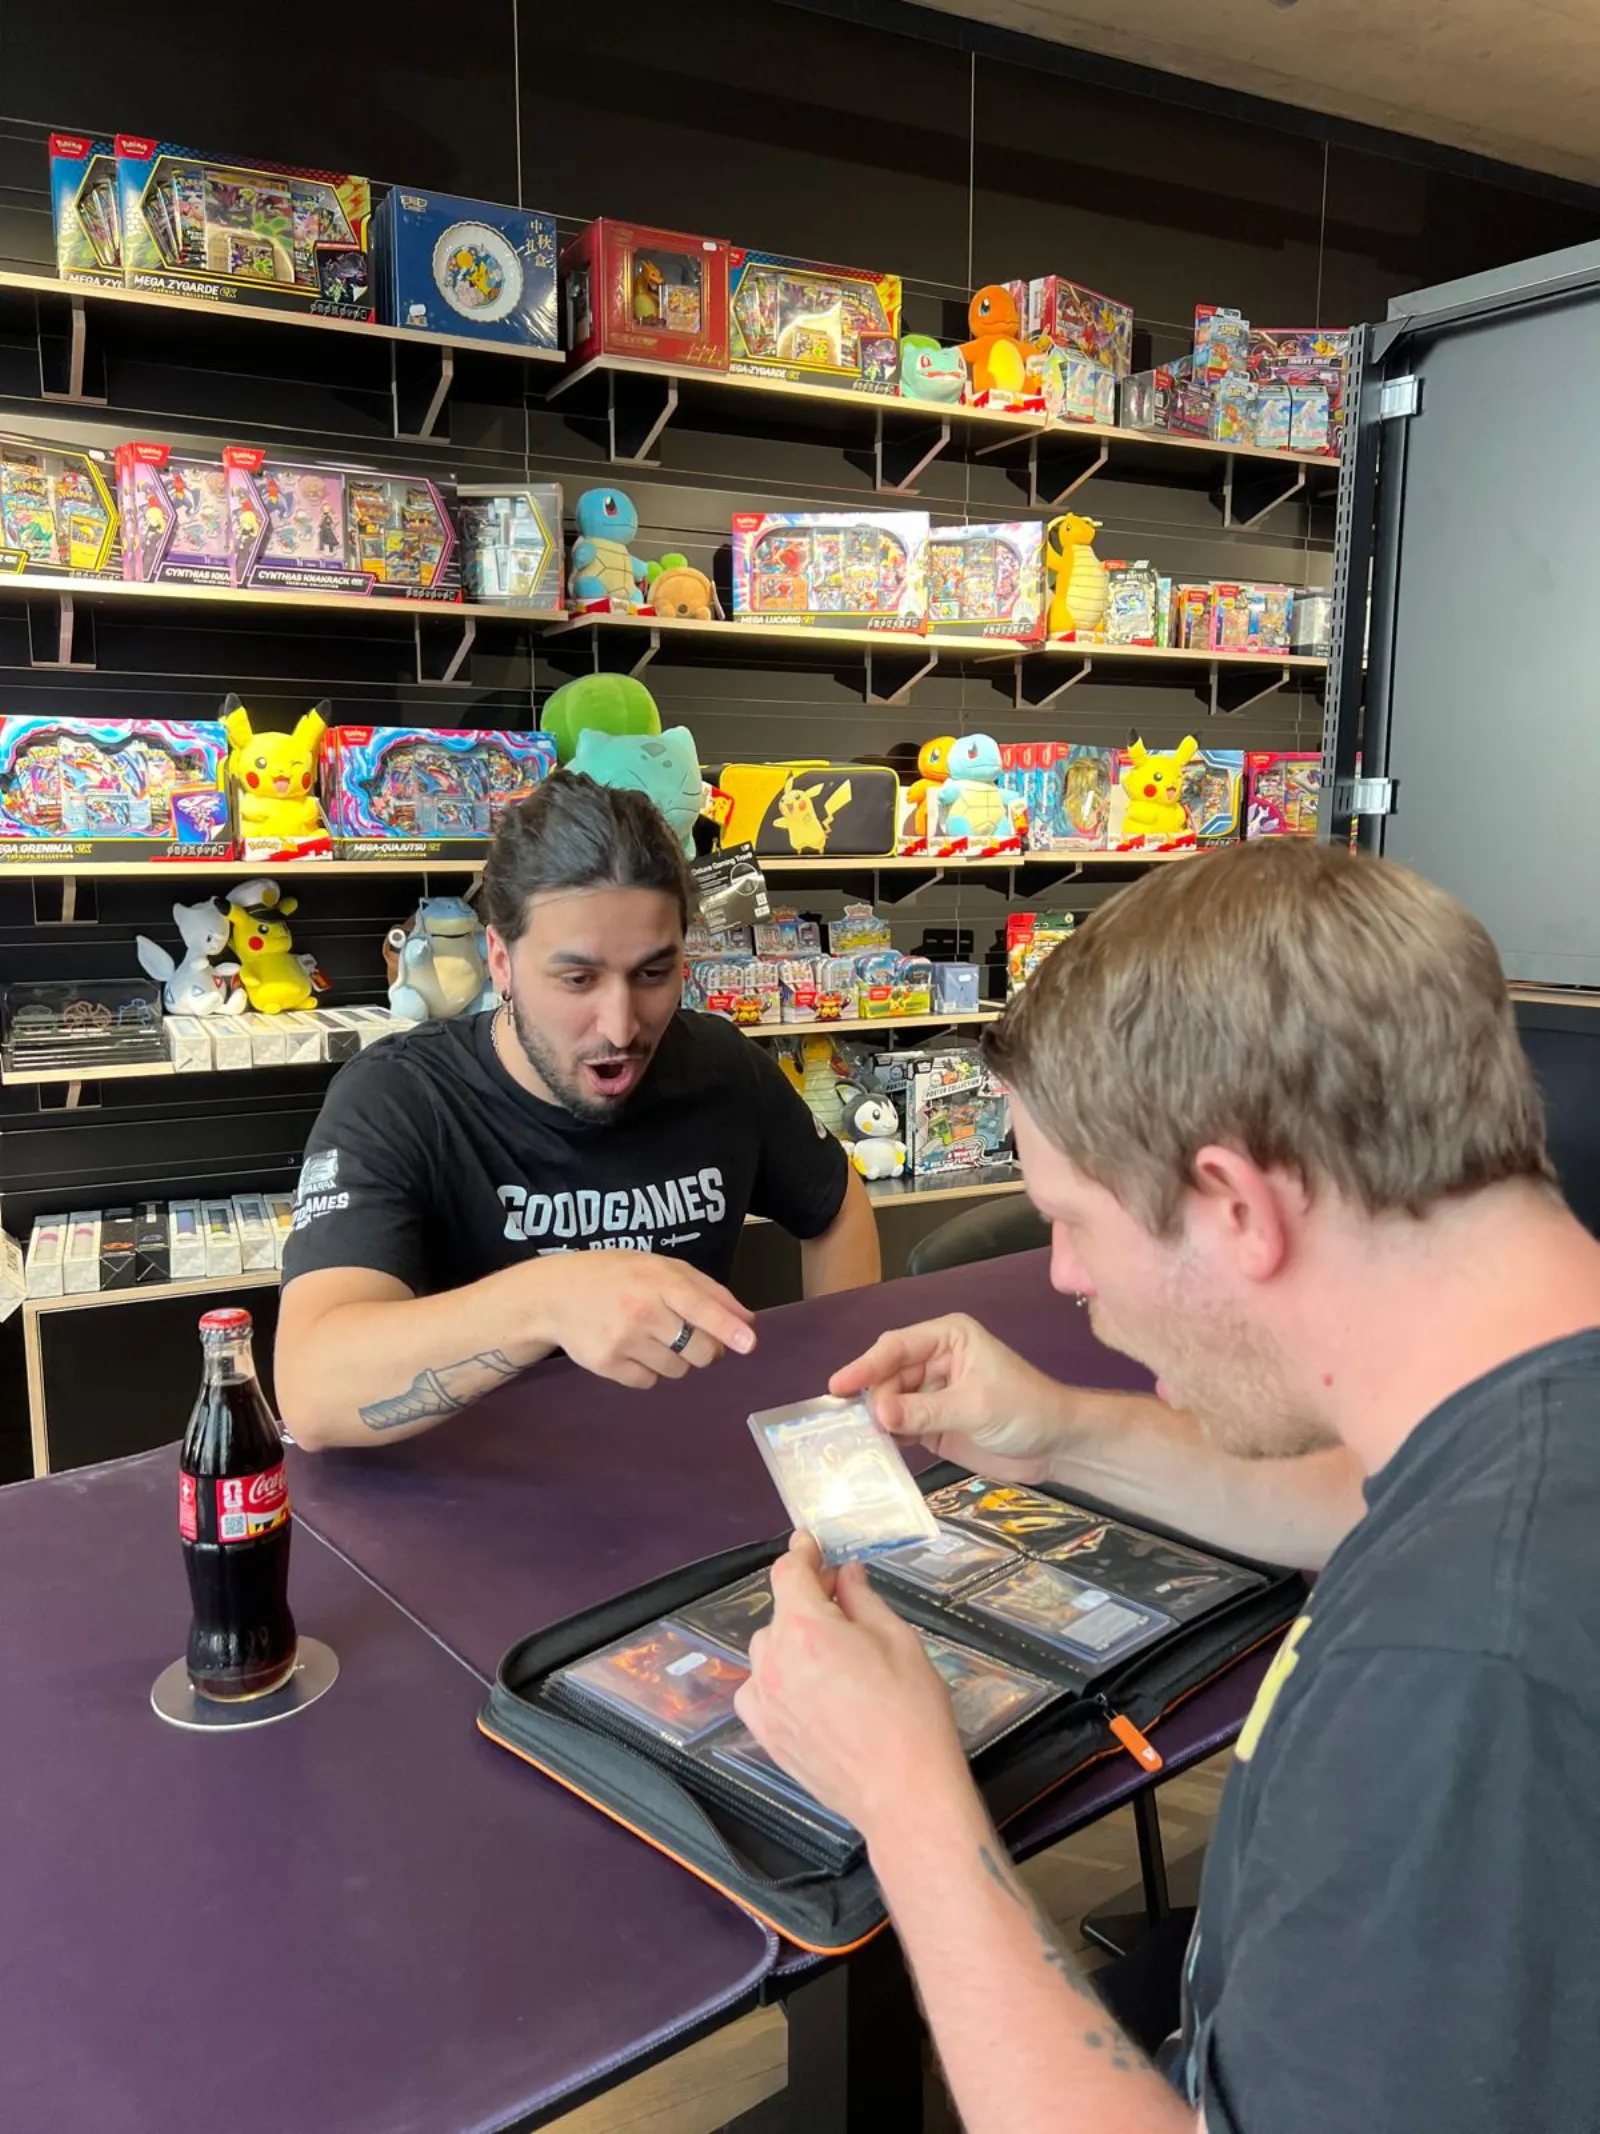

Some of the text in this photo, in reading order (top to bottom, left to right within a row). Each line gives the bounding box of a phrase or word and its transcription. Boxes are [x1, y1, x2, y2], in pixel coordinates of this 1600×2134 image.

[134, 274, 165, 288] MEGA
[168, 279, 220, 296] ZYGARDE
[165, 567, 210, 580] CYNTHIAS
[258, 570, 302, 583] CYNTHIAS
[740, 615, 764, 624] MEGA
[765, 616, 801, 625] LUCARIO
[20, 843, 74, 854] GRENINJA
[354, 843, 427, 853] MEGA-QUAJUTSU
[712, 857, 737, 870] Gaming
[496, 1166, 726, 1242] GOODGAMES
